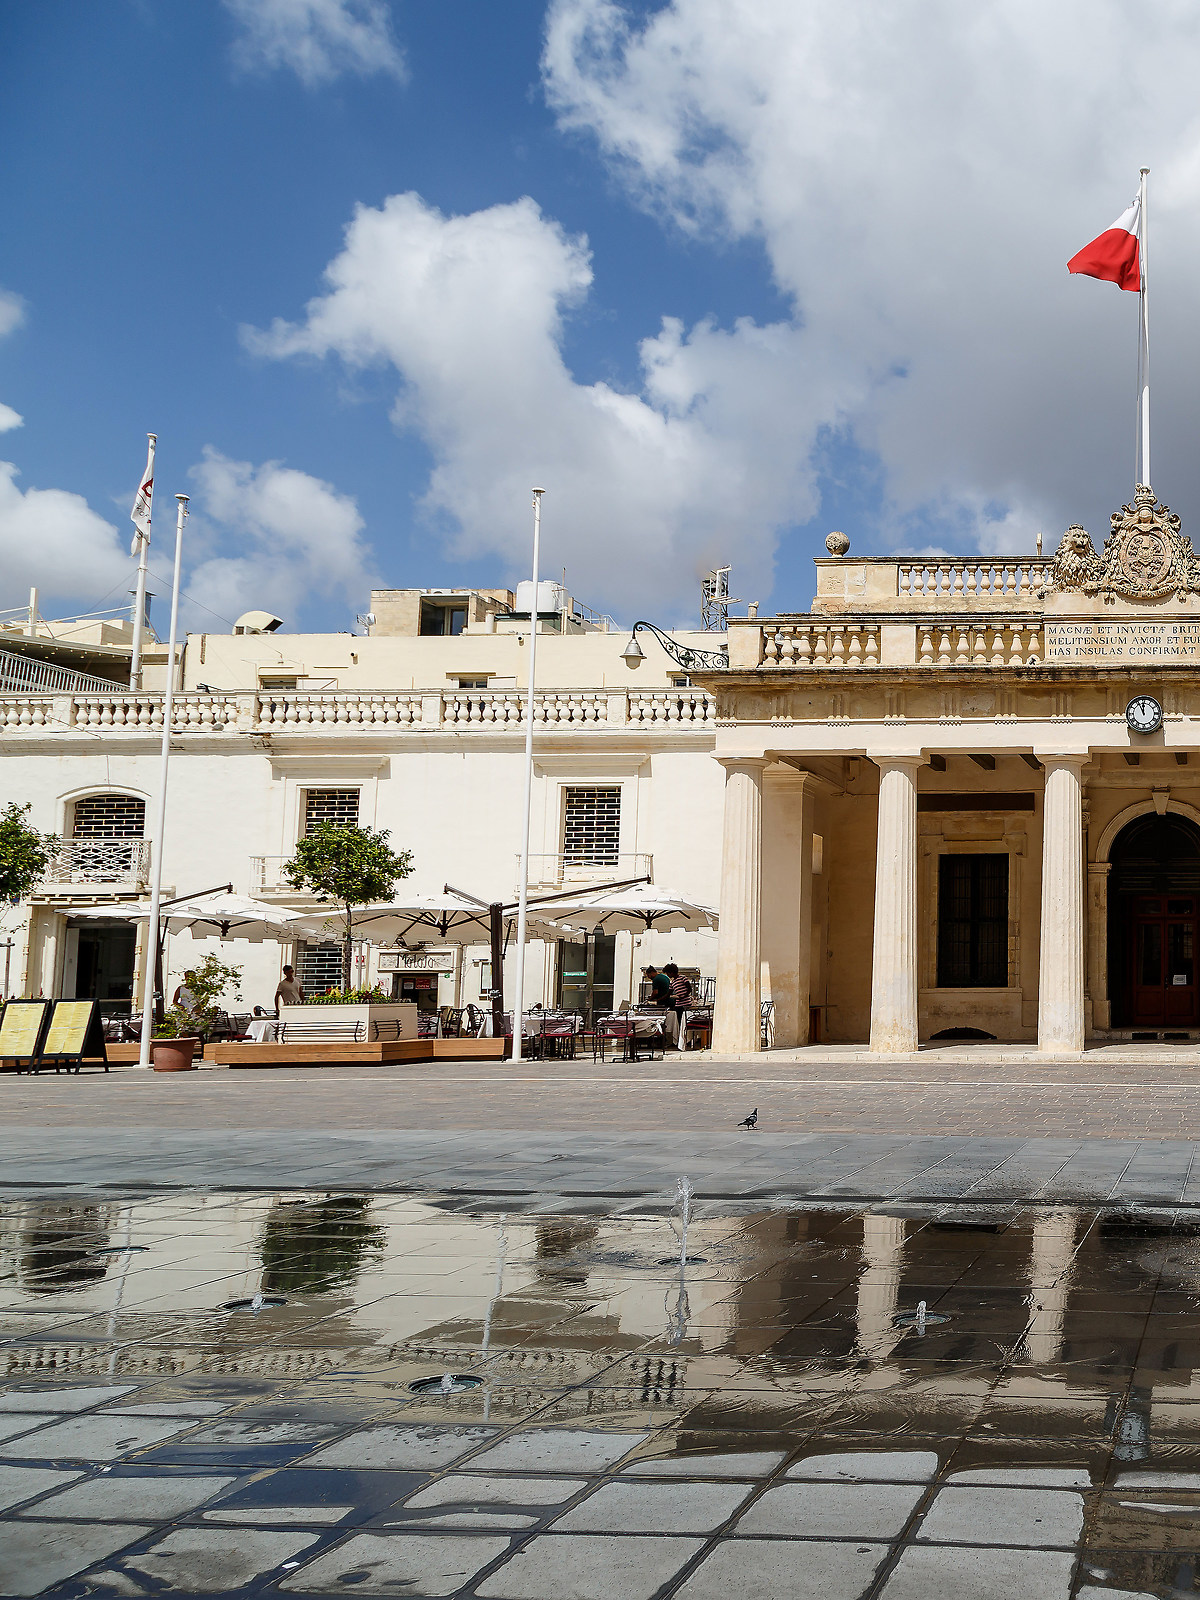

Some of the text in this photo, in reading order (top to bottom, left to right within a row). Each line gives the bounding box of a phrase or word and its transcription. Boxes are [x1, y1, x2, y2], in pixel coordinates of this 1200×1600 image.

[1097, 626, 1113, 634] ET
[1048, 636, 1127, 645] MELITENSIUM
[1131, 636, 1162, 645] AMOR
[1166, 636, 1181, 645] ET
[1049, 647, 1071, 656] HAS
[1074, 647, 1123, 656] INSULAS
[1128, 646, 1196, 656] CONFIRMAT
